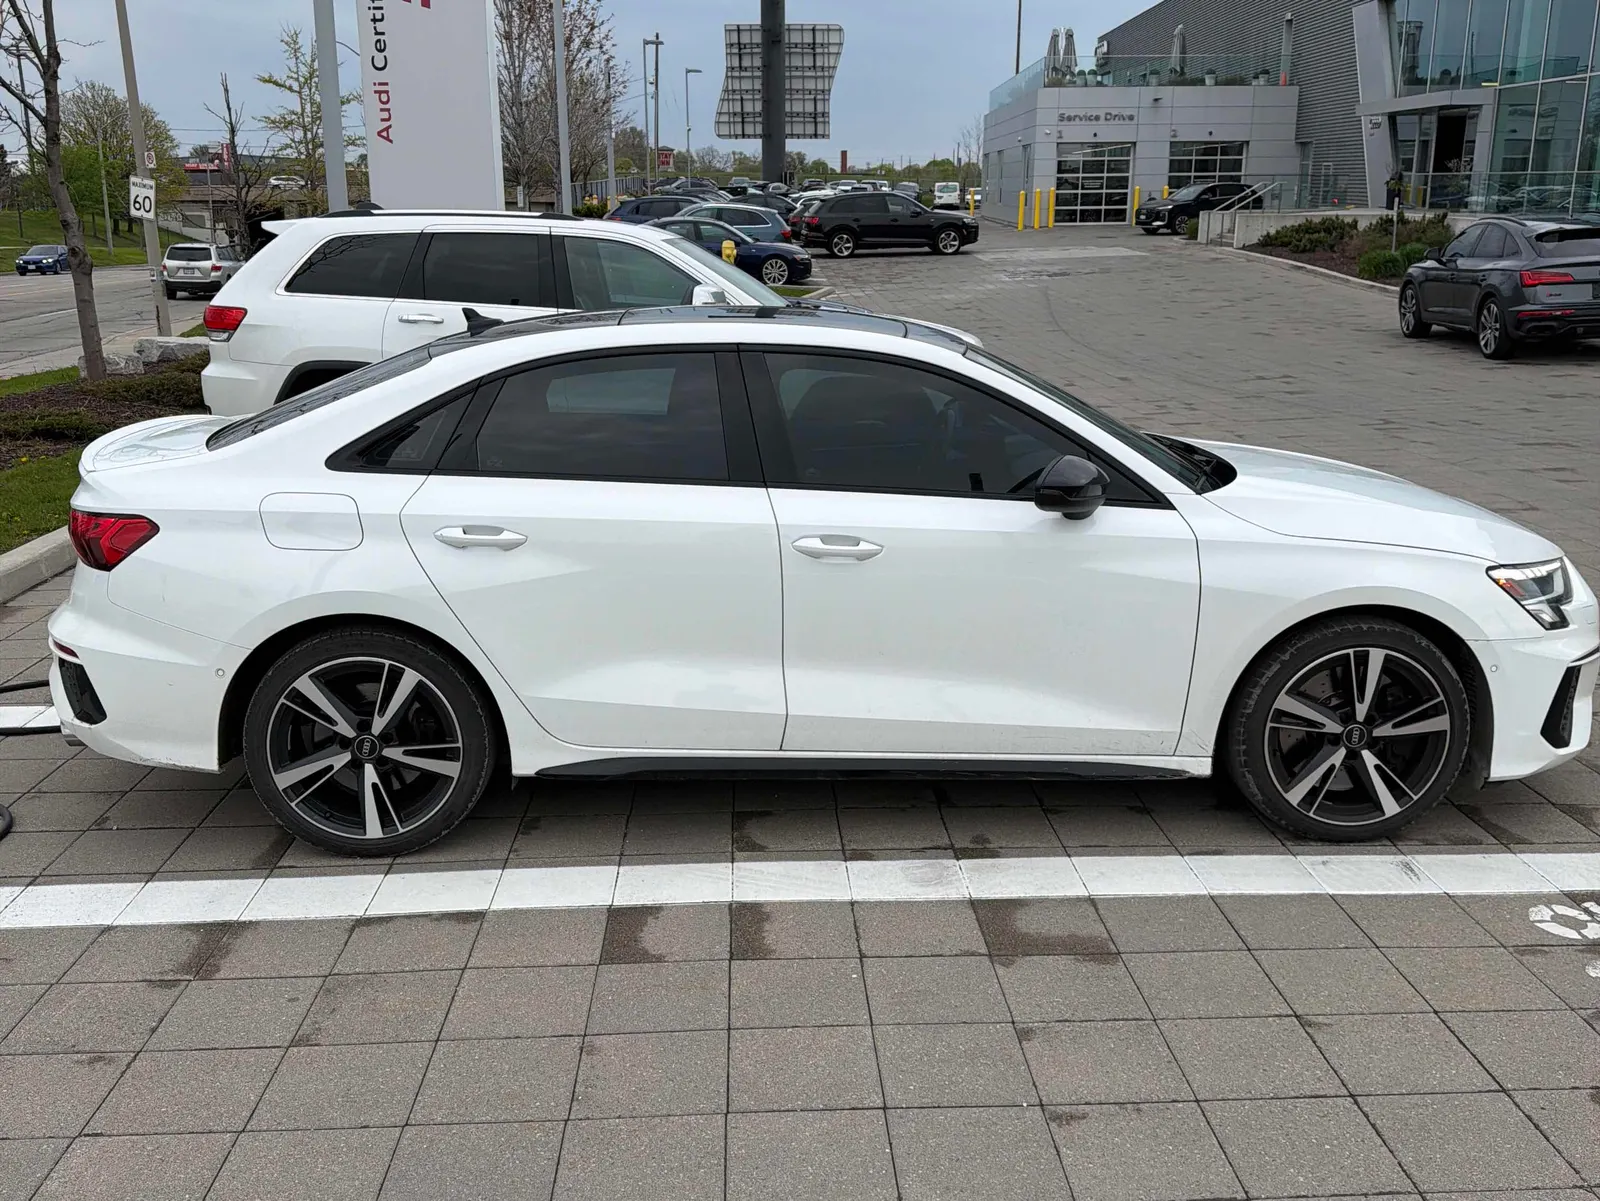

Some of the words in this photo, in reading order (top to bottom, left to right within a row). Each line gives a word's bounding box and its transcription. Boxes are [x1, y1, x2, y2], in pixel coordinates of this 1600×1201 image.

[373, 82, 393, 144] Audi
[1058, 112, 1101, 122] Service
[1104, 112, 1135, 121] Drive
[1057, 129, 1063, 139] 1
[1171, 129, 1178, 138] 2
[132, 181, 153, 190] MAXIMUM
[133, 194, 152, 213] 60
